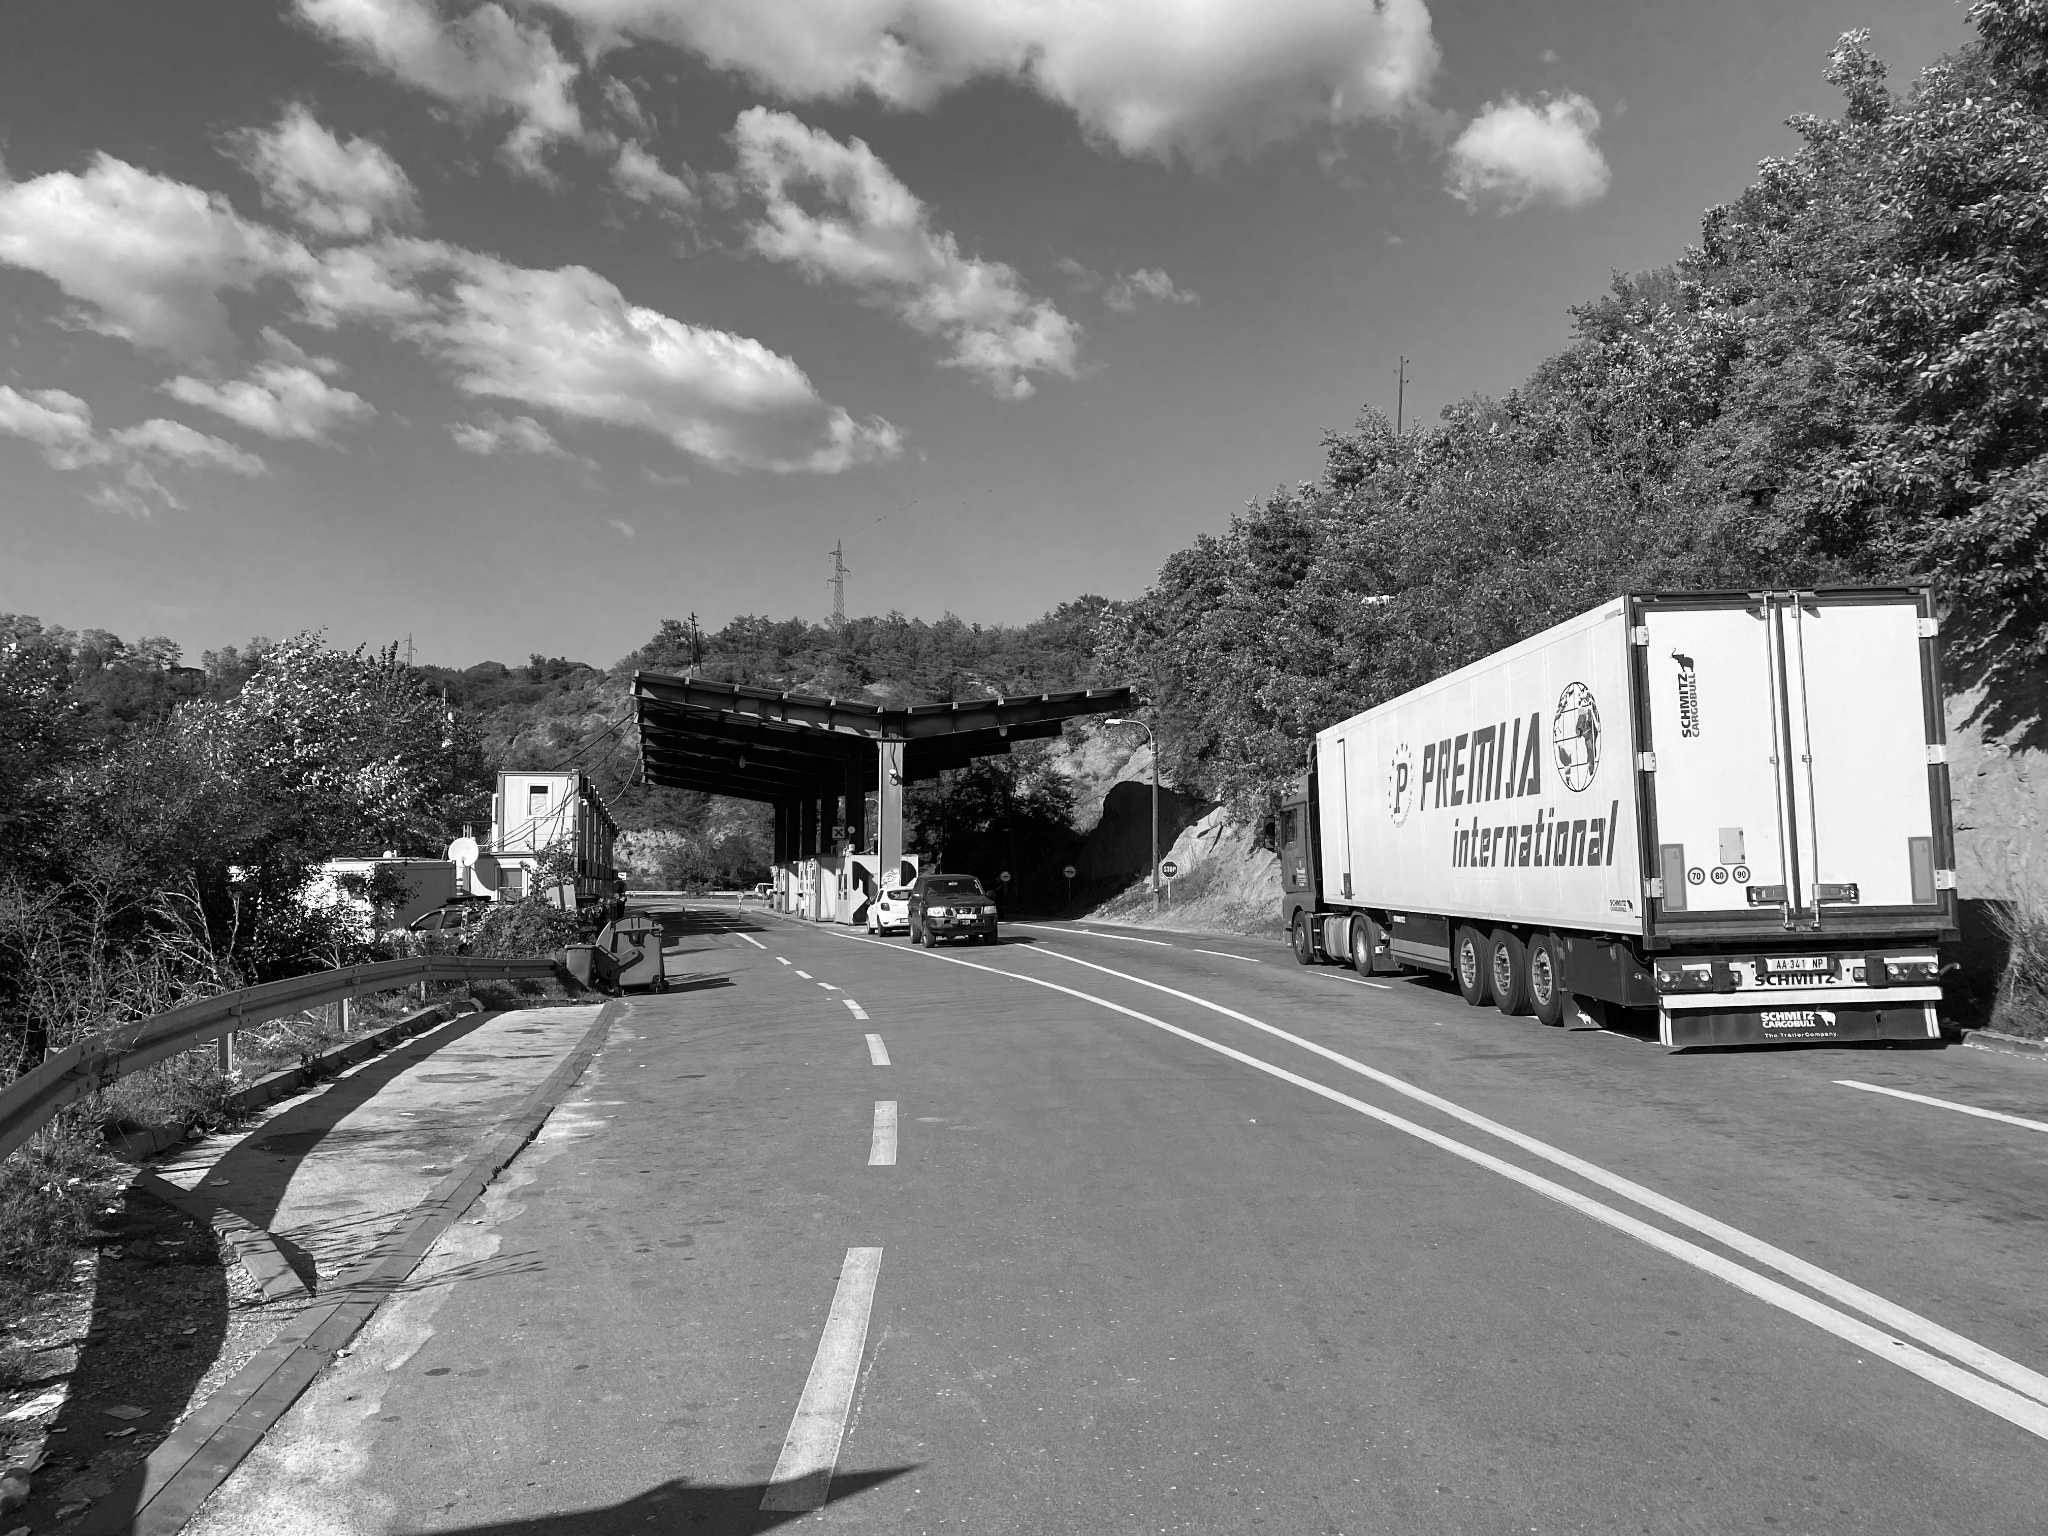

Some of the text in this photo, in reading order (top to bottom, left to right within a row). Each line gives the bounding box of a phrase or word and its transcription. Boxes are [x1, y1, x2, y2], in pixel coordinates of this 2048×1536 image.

[1678, 673, 1692, 738] SCHMITZ
[1688, 673, 1700, 738] CARGOBULL
[1420, 712, 1541, 811] PREMIJA
[1452, 800, 1619, 867] international
[1163, 865, 1177, 873] STOP
[1737, 870, 1747, 879] 90
[1691, 872, 1701, 880] 70
[1715, 872, 1724, 880] 80
[1754, 973, 1836, 987] SCHMITZ
[1760, 1010, 1816, 1021] SCHMITZ
[1762, 1020, 1816, 1029] CARGOBULL
